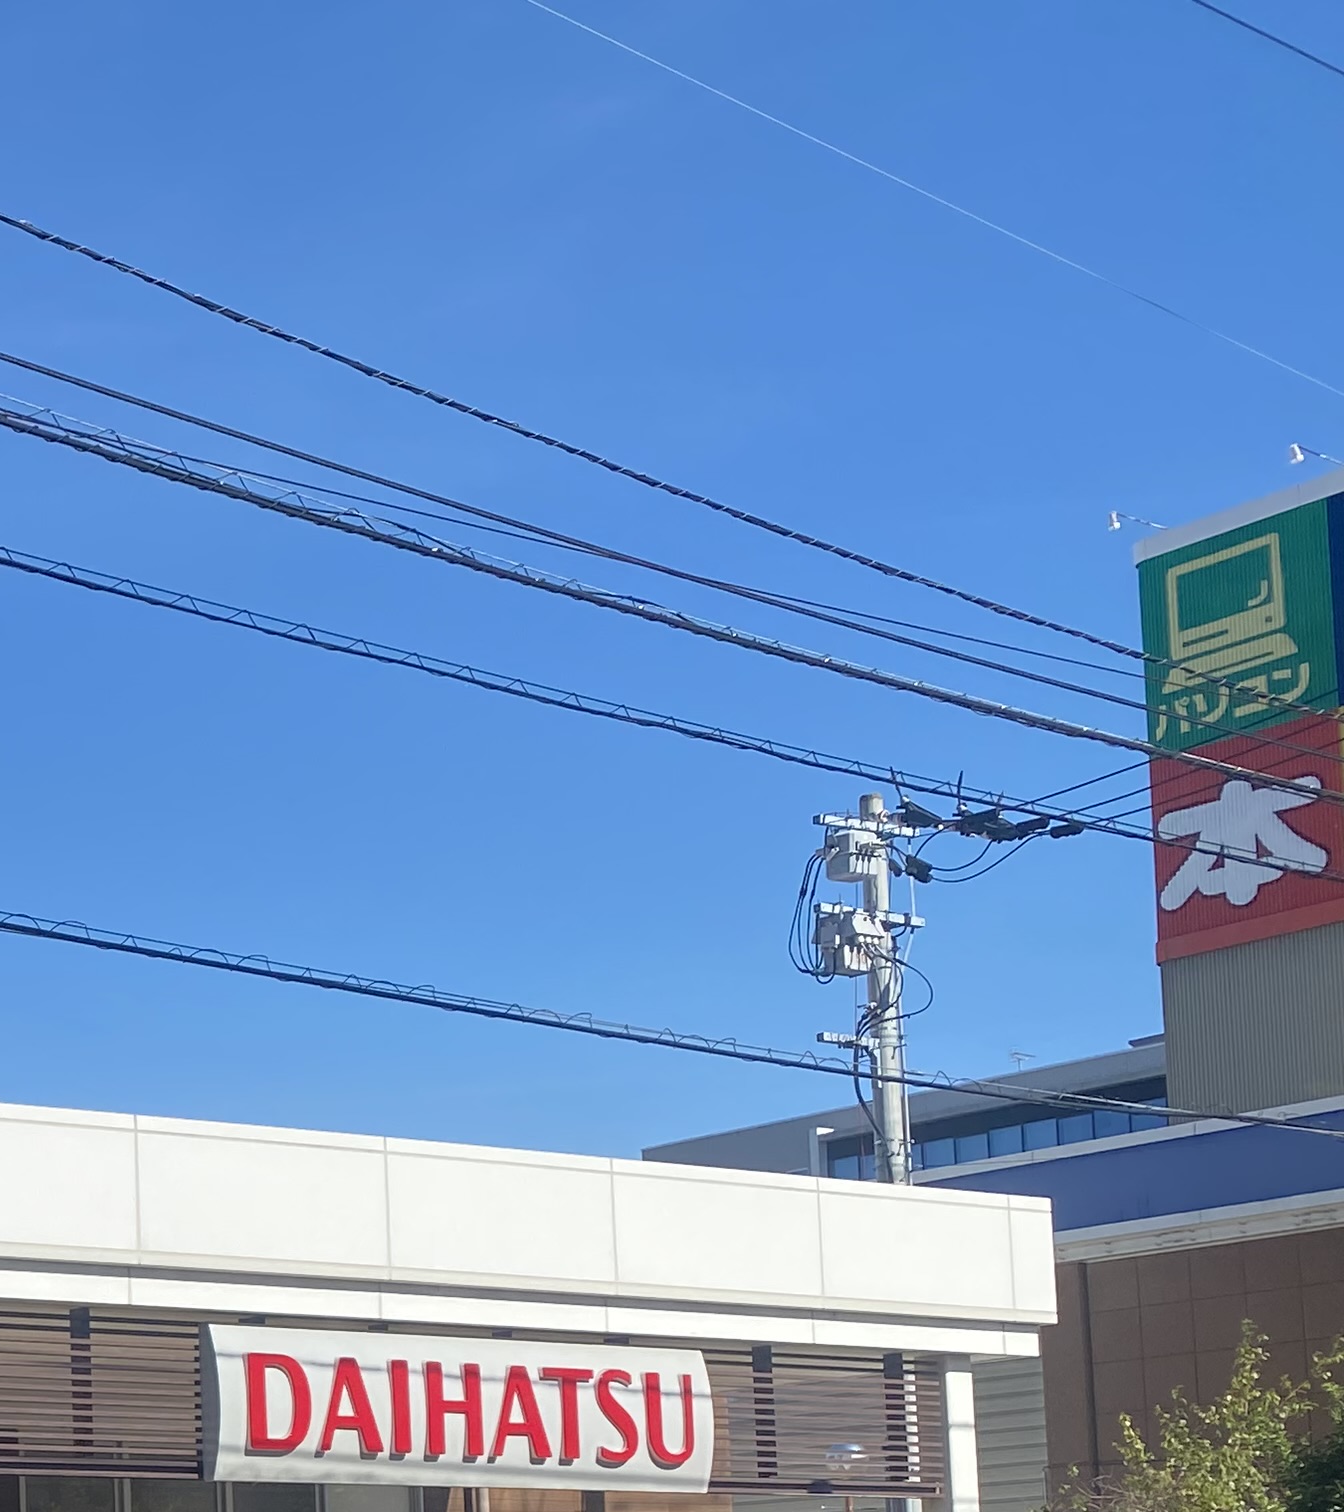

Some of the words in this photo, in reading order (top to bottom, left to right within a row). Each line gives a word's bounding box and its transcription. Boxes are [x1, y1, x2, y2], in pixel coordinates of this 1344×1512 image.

[1156, 662, 1310, 742] パソコン
[1158, 775, 1328, 911] 本
[244, 1352, 695, 1467] DAIHATSU
